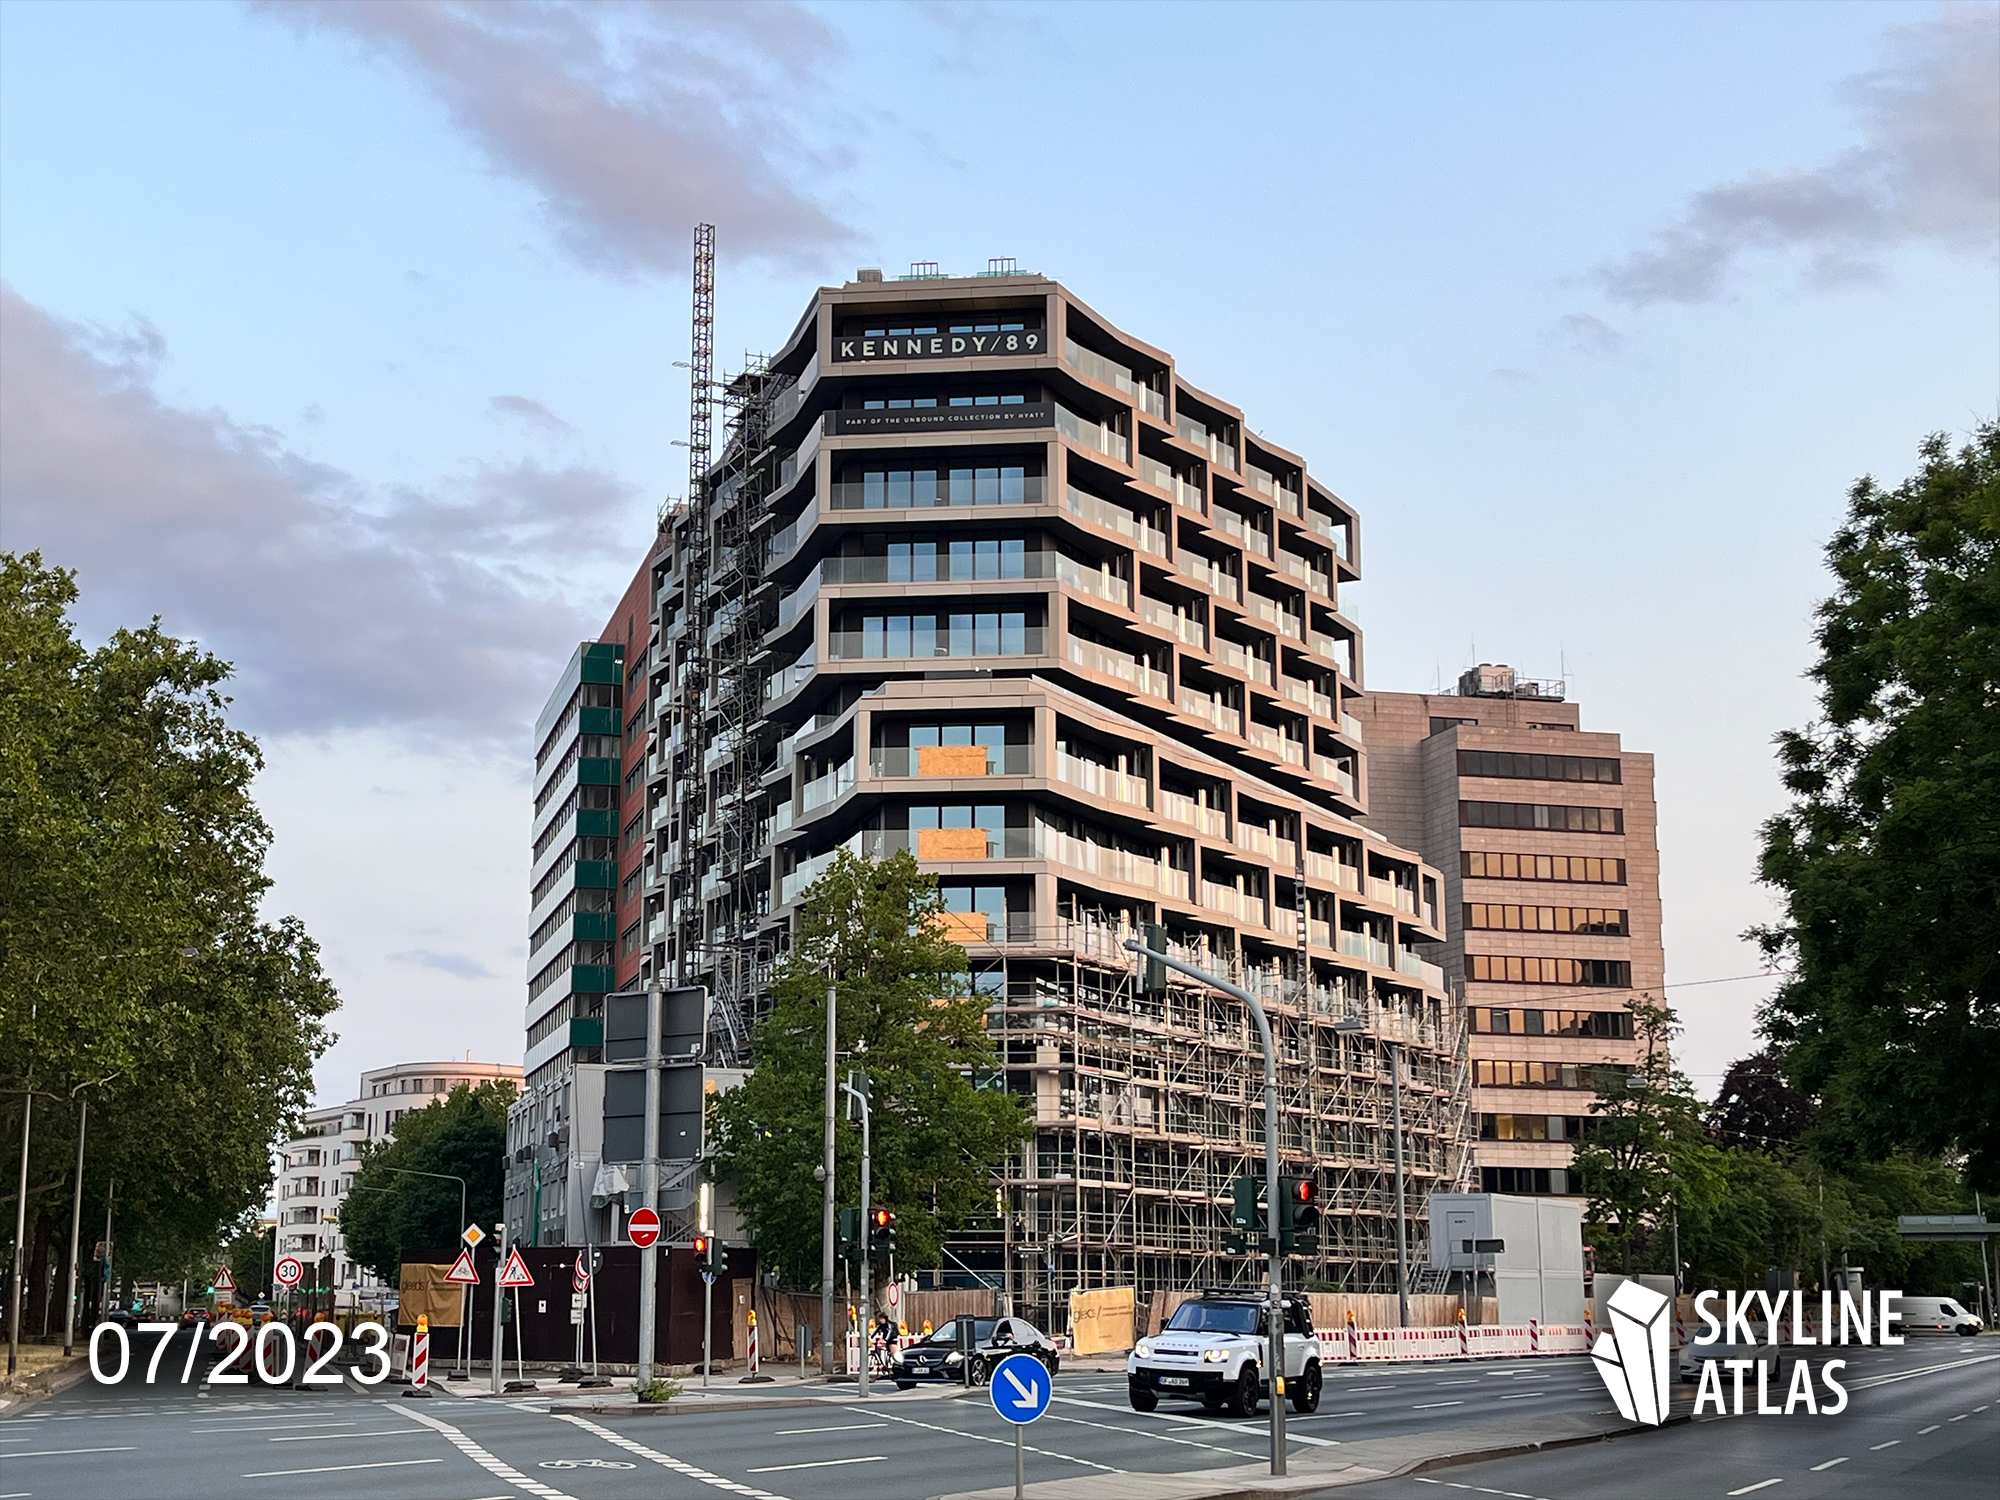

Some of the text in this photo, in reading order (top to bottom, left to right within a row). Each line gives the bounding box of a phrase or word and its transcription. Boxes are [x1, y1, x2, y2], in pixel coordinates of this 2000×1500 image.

[841, 334, 1039, 357] KENNEDY/89
[904, 415, 945, 423] UNBOUND
[948, 414, 1000, 422] COLLECTION
[281, 1265, 297, 1277] 30
